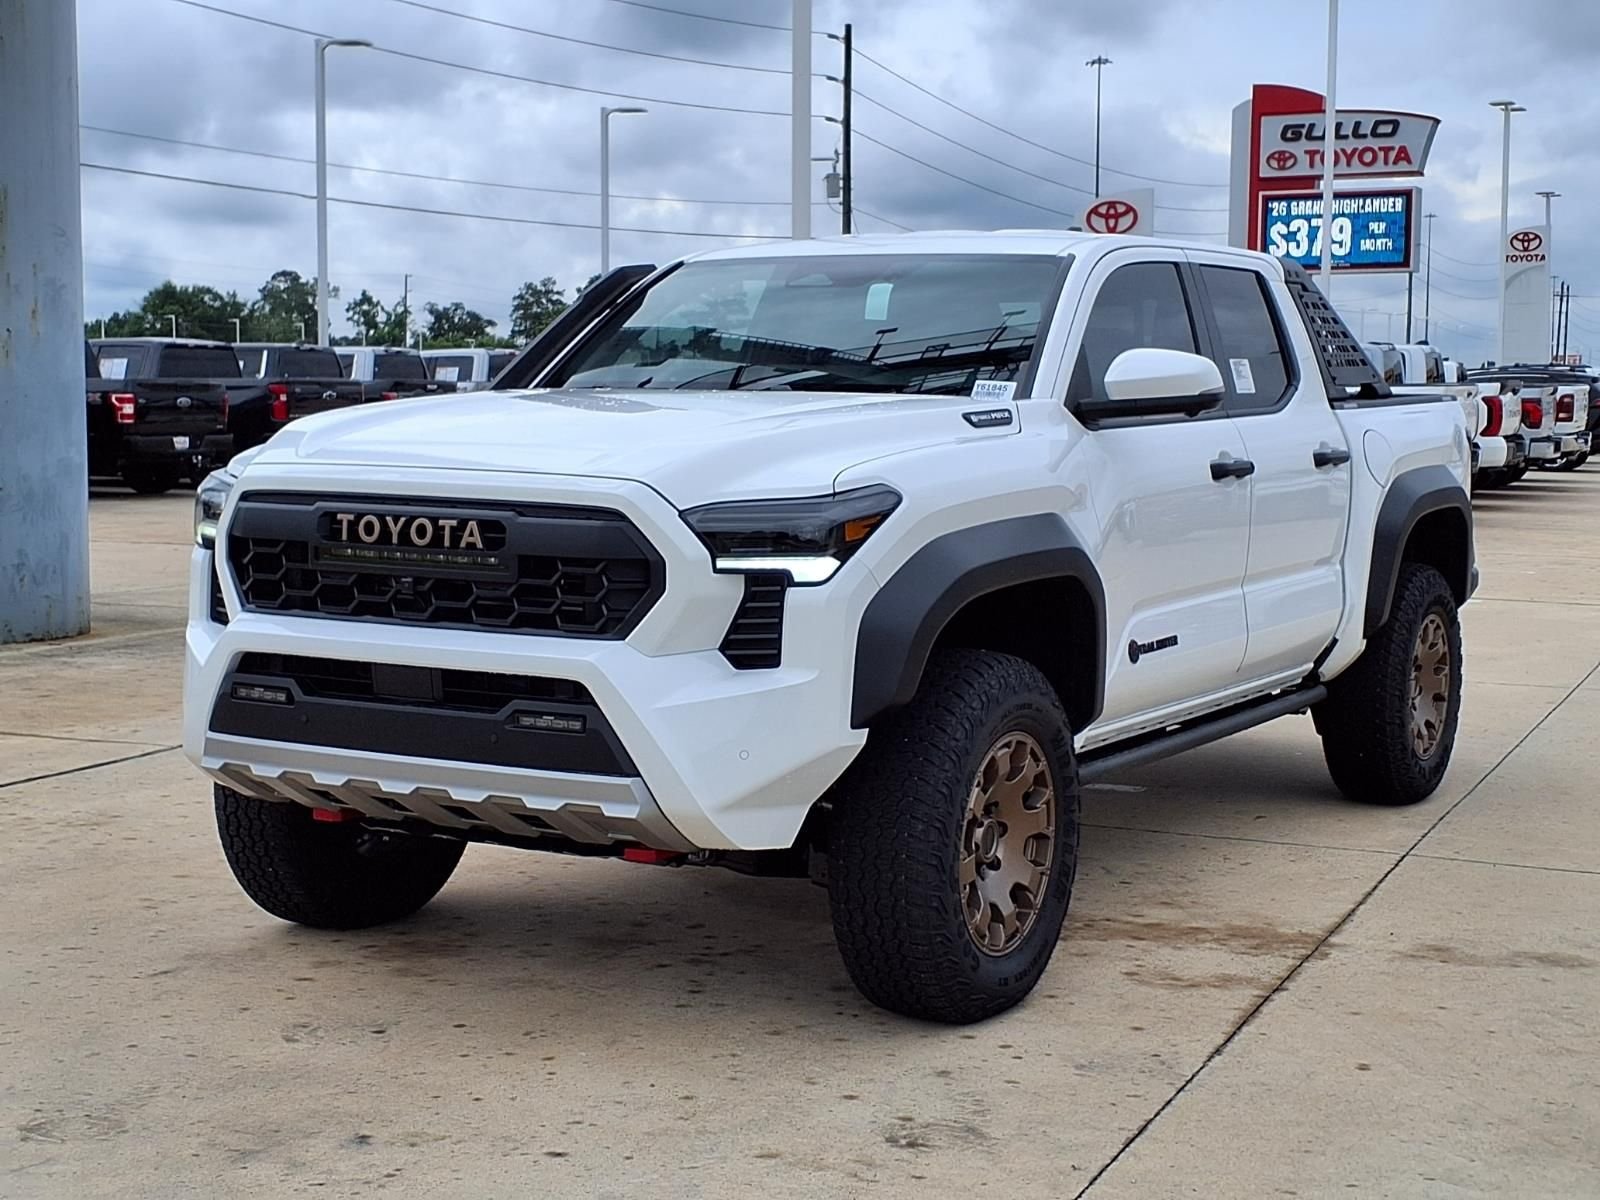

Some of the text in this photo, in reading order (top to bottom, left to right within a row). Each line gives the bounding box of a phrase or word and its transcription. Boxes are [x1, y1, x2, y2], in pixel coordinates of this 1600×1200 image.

[1280, 119, 1400, 142] GULLO
[1304, 145, 1412, 168] TOYOTA
[1290, 199, 1324, 215] GRAN
[1331, 197, 1403, 214] HIGHLANDER
[1268, 217, 1352, 257] $379
[1368, 221, 1386, 234] PER
[1360, 238, 1393, 251] MONTH
[1505, 254, 1546, 263] TOYOTA
[336, 513, 484, 549] TOYOTA
